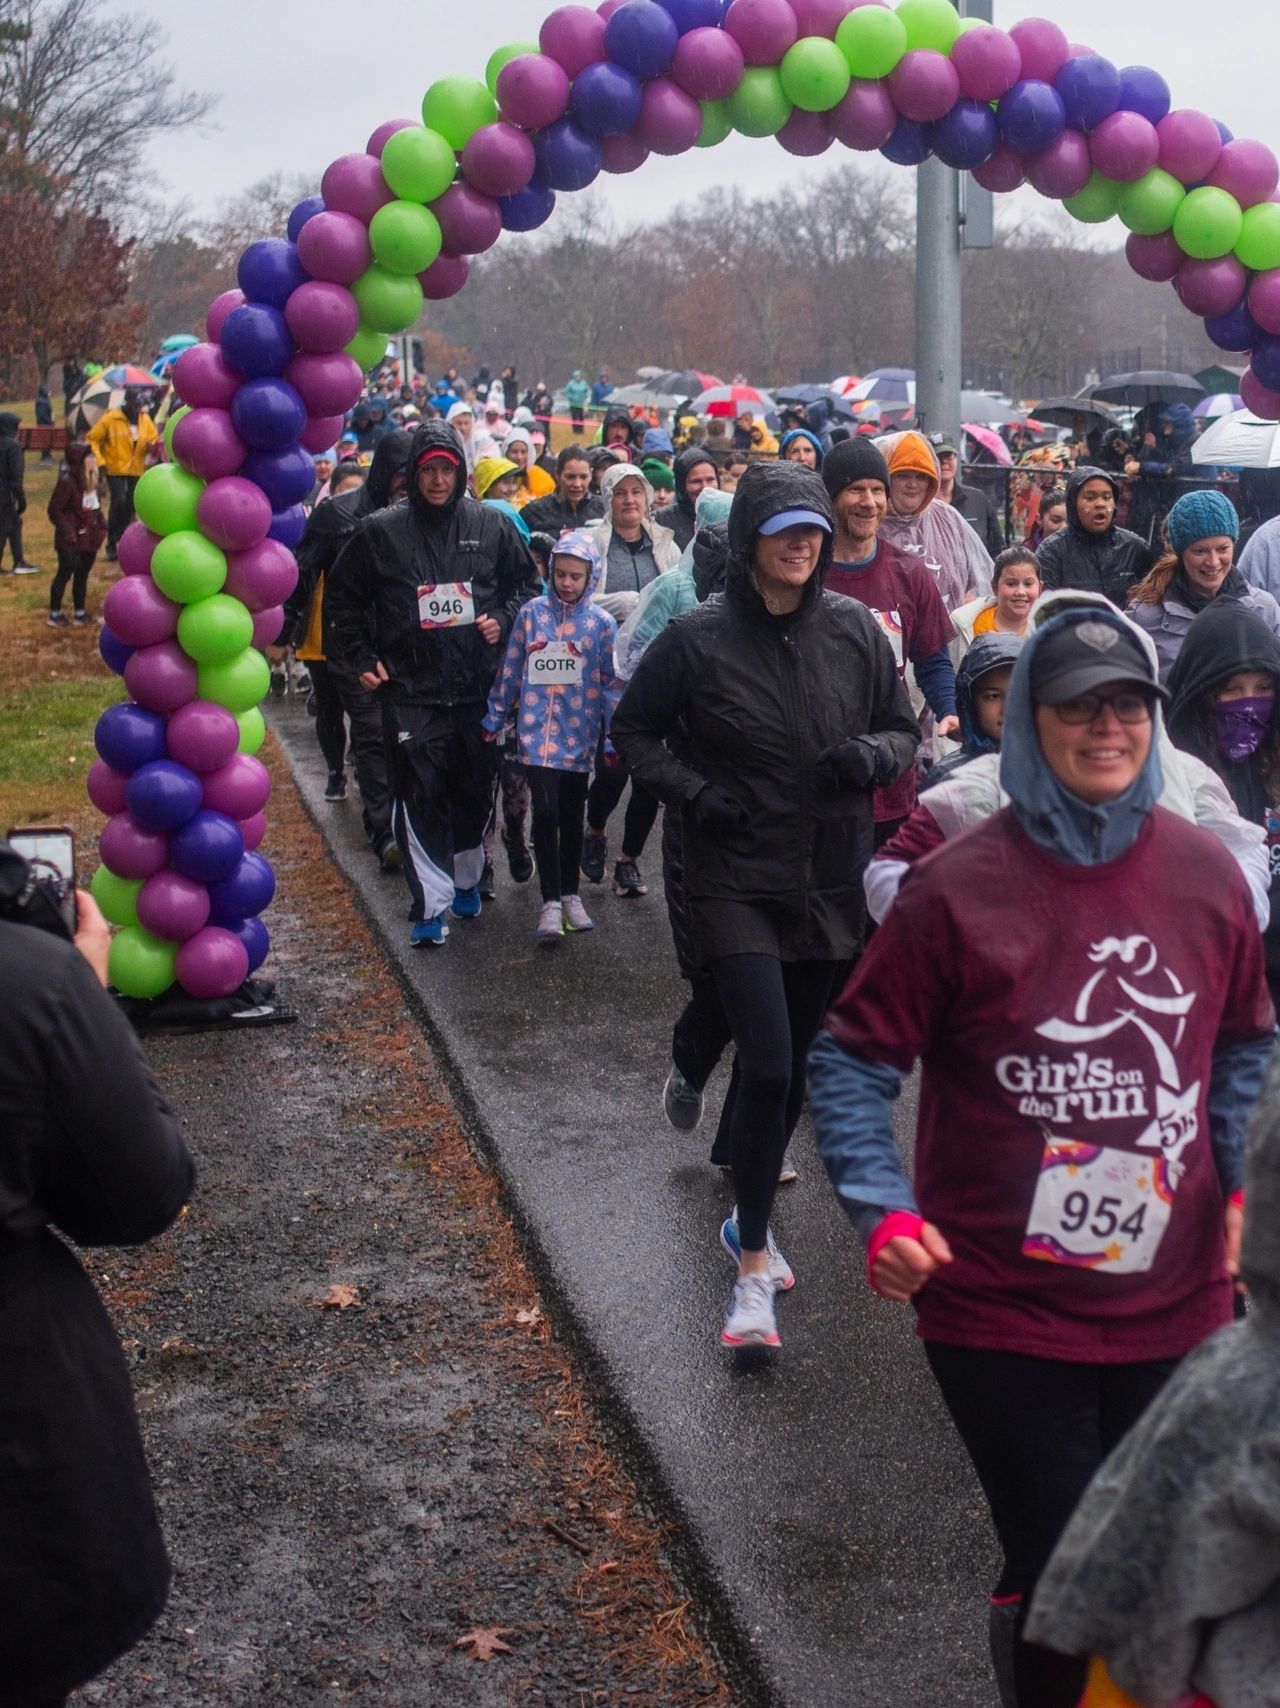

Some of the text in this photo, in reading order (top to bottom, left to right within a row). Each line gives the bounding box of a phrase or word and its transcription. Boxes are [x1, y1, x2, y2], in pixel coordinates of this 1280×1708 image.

[429, 600, 463, 616] 946
[535, 659, 576, 671] GOTR
[995, 1051, 1144, 1094] Girls on
[1018, 1086, 1149, 1123] the run
[1060, 1191, 1147, 1242] 954
